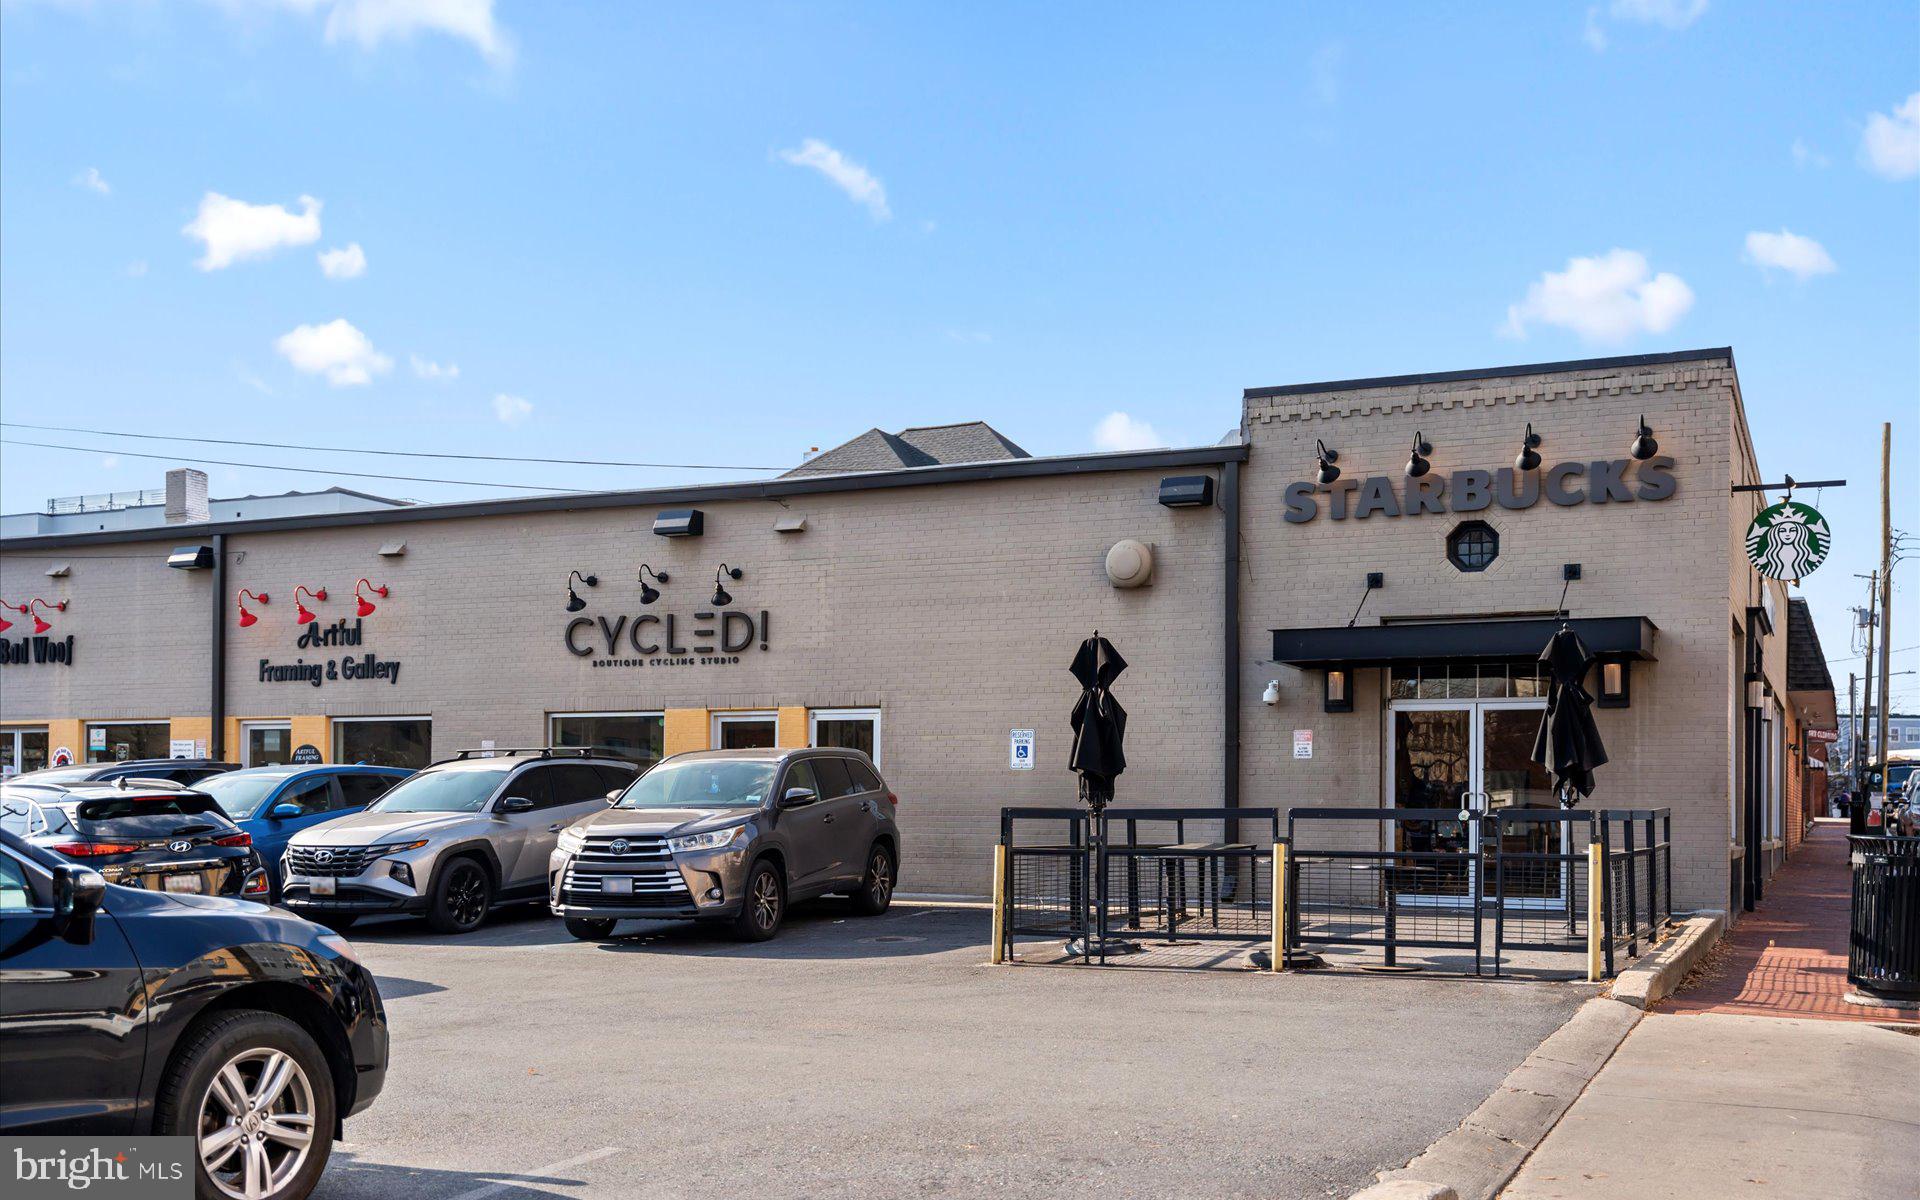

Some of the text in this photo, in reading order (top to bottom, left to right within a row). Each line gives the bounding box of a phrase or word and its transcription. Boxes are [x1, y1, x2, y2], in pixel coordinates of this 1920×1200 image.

[1284, 456, 1677, 523] STARBUCKS
[297, 618, 362, 649] Artful
[565, 611, 769, 657] CYCLED!
[0, 635, 74, 666] Bad Woof
[592, 656, 740, 668] BOUTIQUE CYCLING STUDIO
[259, 653, 400, 687] Framing & Gallery
[1874, 773, 1882, 783] P
